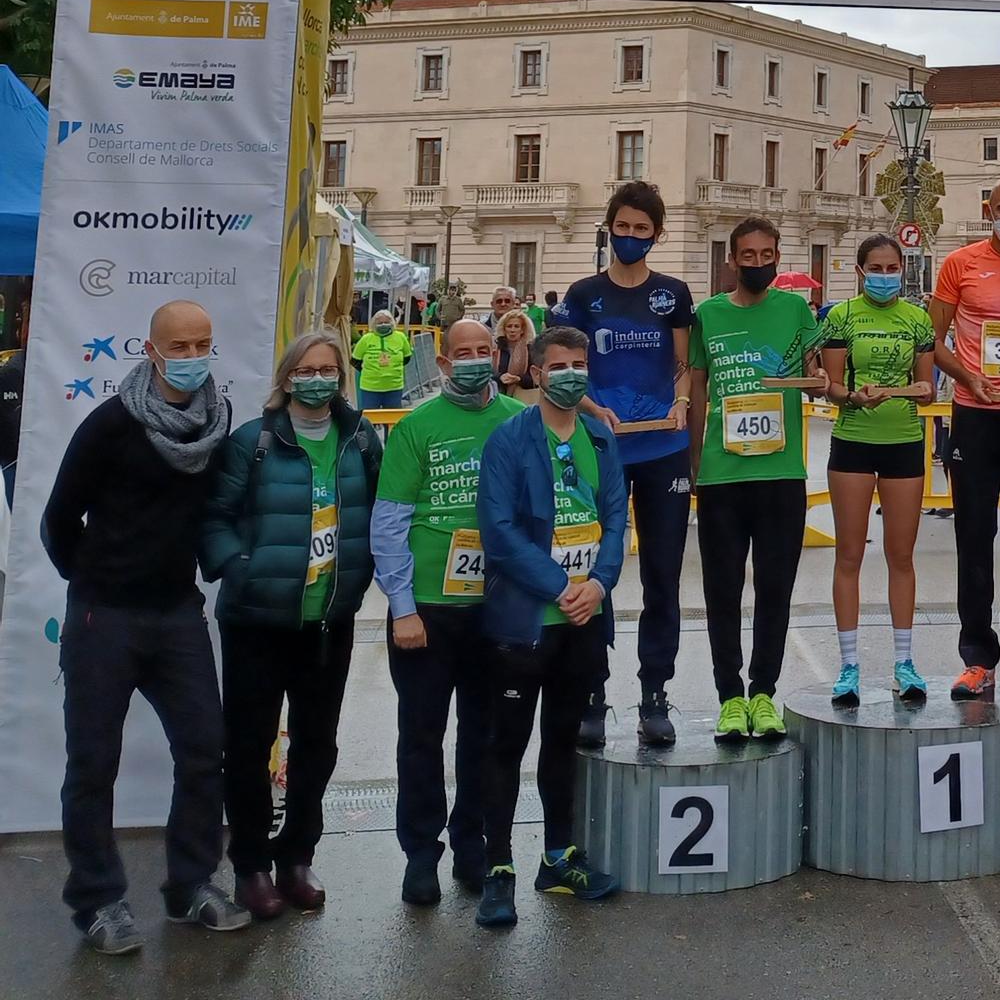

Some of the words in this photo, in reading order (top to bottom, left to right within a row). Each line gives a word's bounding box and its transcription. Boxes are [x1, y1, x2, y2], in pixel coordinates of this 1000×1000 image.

[106, 11, 154, 23] Ajuntament
[170, 15, 182, 23] de
[183, 16, 209, 24] Palma
[233, 16, 260, 27] IME
[180, 90, 208, 102] Palma
[210, 91, 234, 102] verda
[89, 123, 124, 134] IMAS
[88, 137, 177, 151] Departament
[180, 140, 196, 151] de
[200, 140, 232, 152] Drets
[237, 140, 279, 153] Socials
[87, 152, 135, 165] Consell
[139, 153, 156, 165] de
[160, 154, 214, 167] Mallorca
[127, 267, 236, 288] marcapital
[615, 330, 661, 342] indurco
[708, 341, 724, 354] En
[714, 366, 755, 382] contra
[716, 383, 725, 395] el
[727, 379, 763, 393] cánc
[737, 415, 770, 436] 450
[429, 448, 449, 463] En
[429, 457, 481, 478] march
[430, 476, 480, 492] contra
[430, 492, 446, 506] el
[449, 490, 477, 504] cán
[554, 511, 591, 525] áncer
[310, 530, 338, 560] 09
[455, 554, 484, 575] 24
[933, 753, 963, 823] 1
[668, 796, 715, 867] 2
